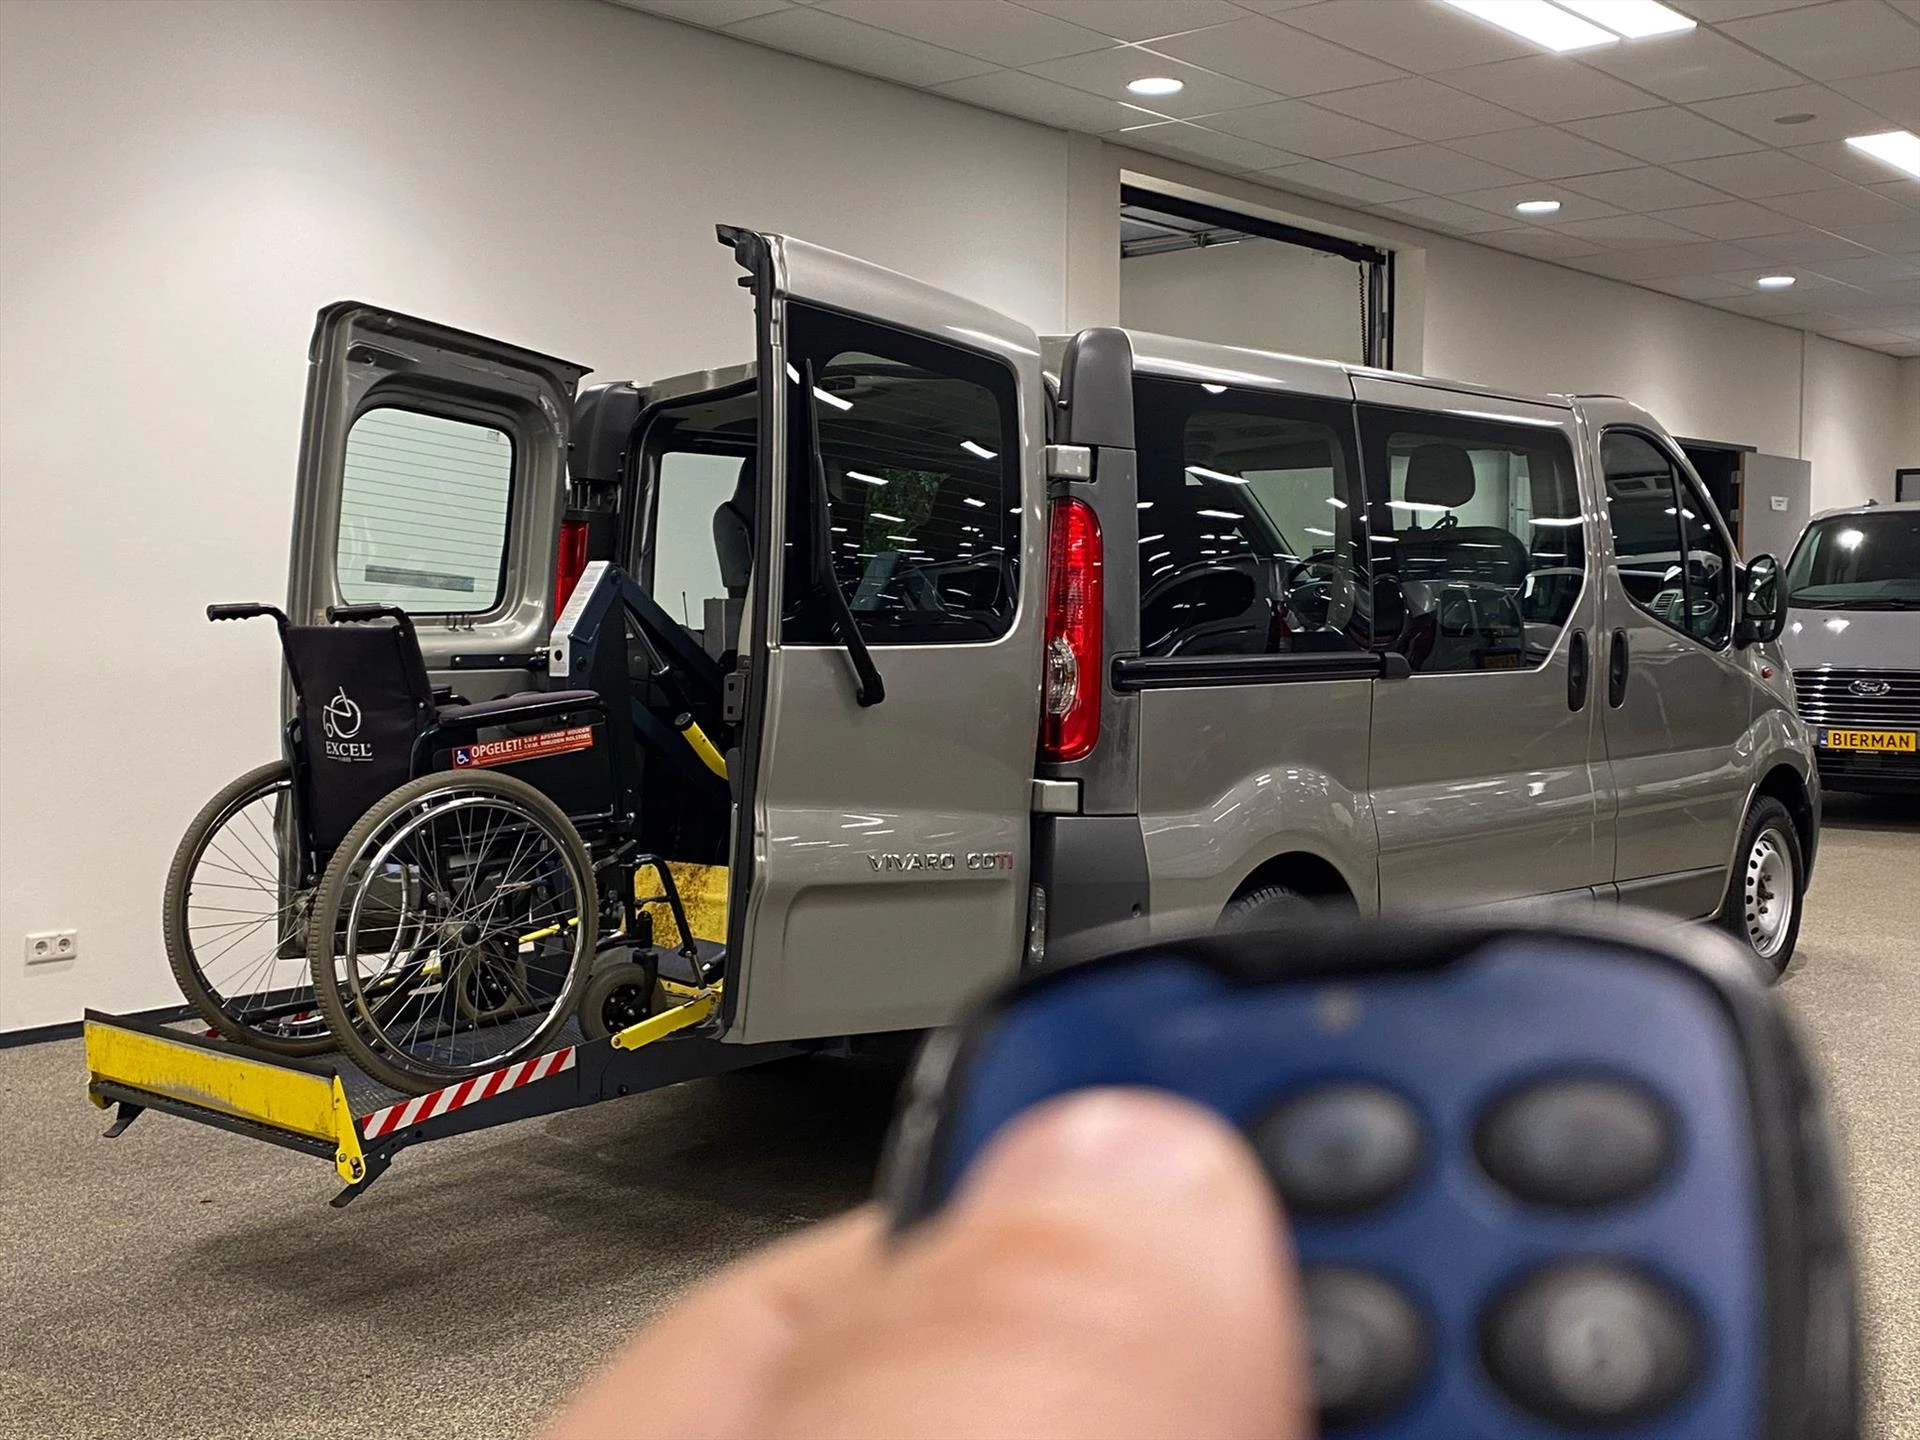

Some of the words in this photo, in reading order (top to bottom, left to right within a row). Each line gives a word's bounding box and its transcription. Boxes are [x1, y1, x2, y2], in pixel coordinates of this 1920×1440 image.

[471, 739, 522, 758] OPGELET!
[1832, 732, 1911, 749] BIERMAN
[867, 853, 955, 872] VIVARO
